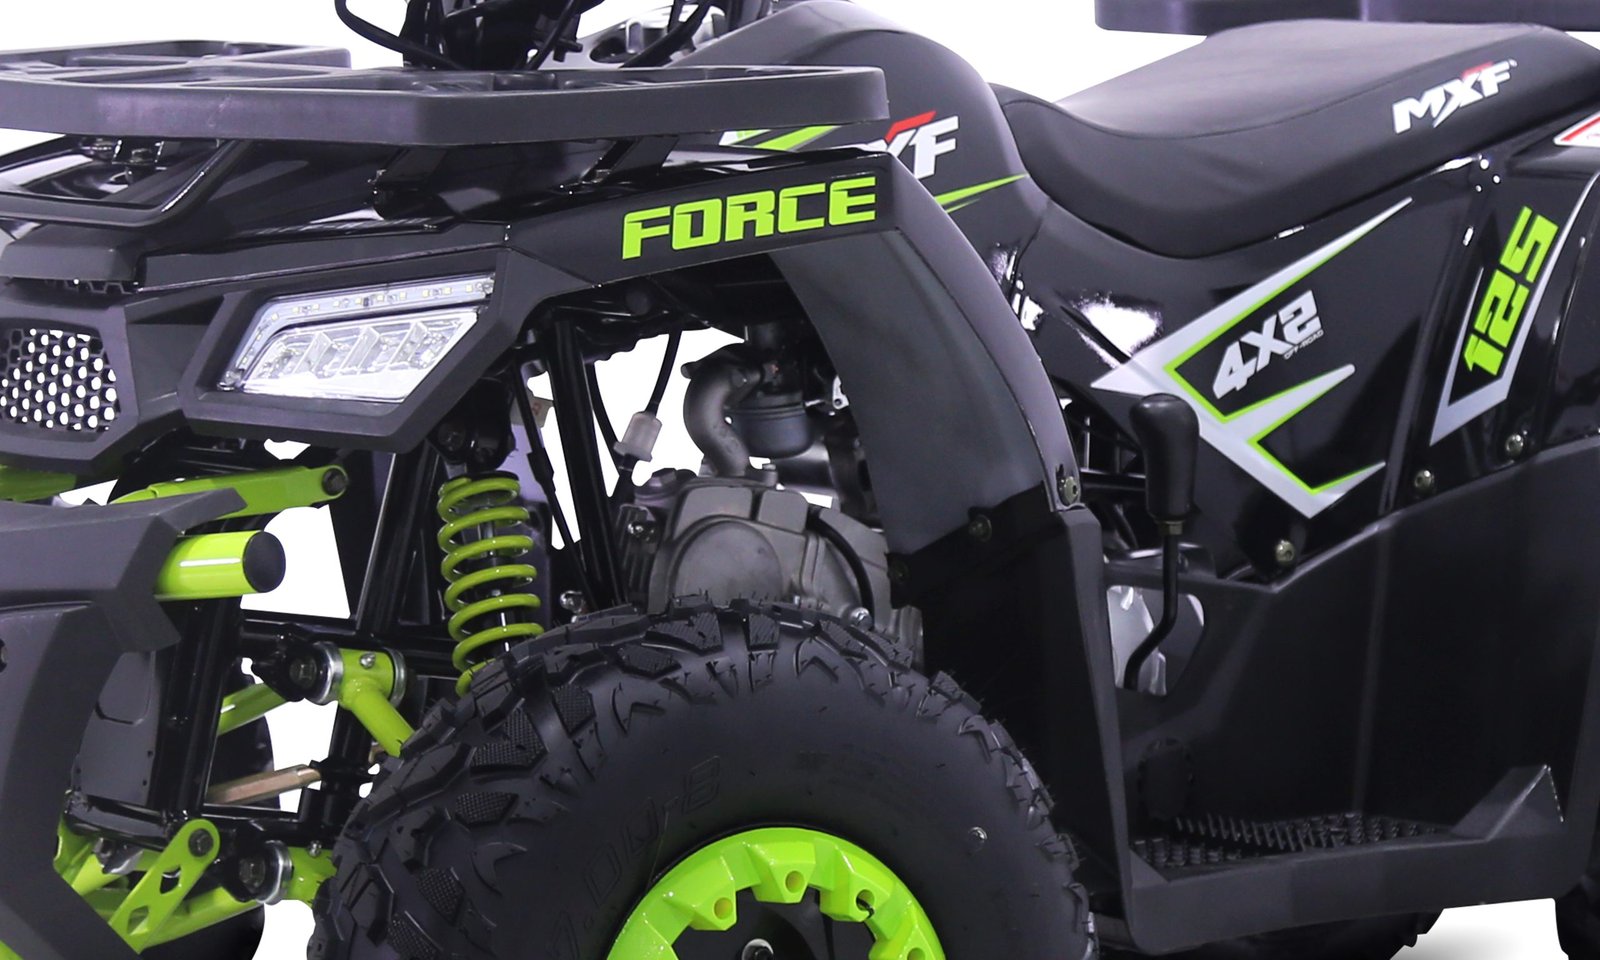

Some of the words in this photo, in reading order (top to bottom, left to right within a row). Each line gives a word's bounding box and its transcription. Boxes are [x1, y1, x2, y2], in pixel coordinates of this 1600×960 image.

[1392, 60, 1512, 134] MXF
[622, 176, 877, 260] FORCE
[1462, 205, 1559, 376] 125
[1212, 289, 1322, 400] 4X2
